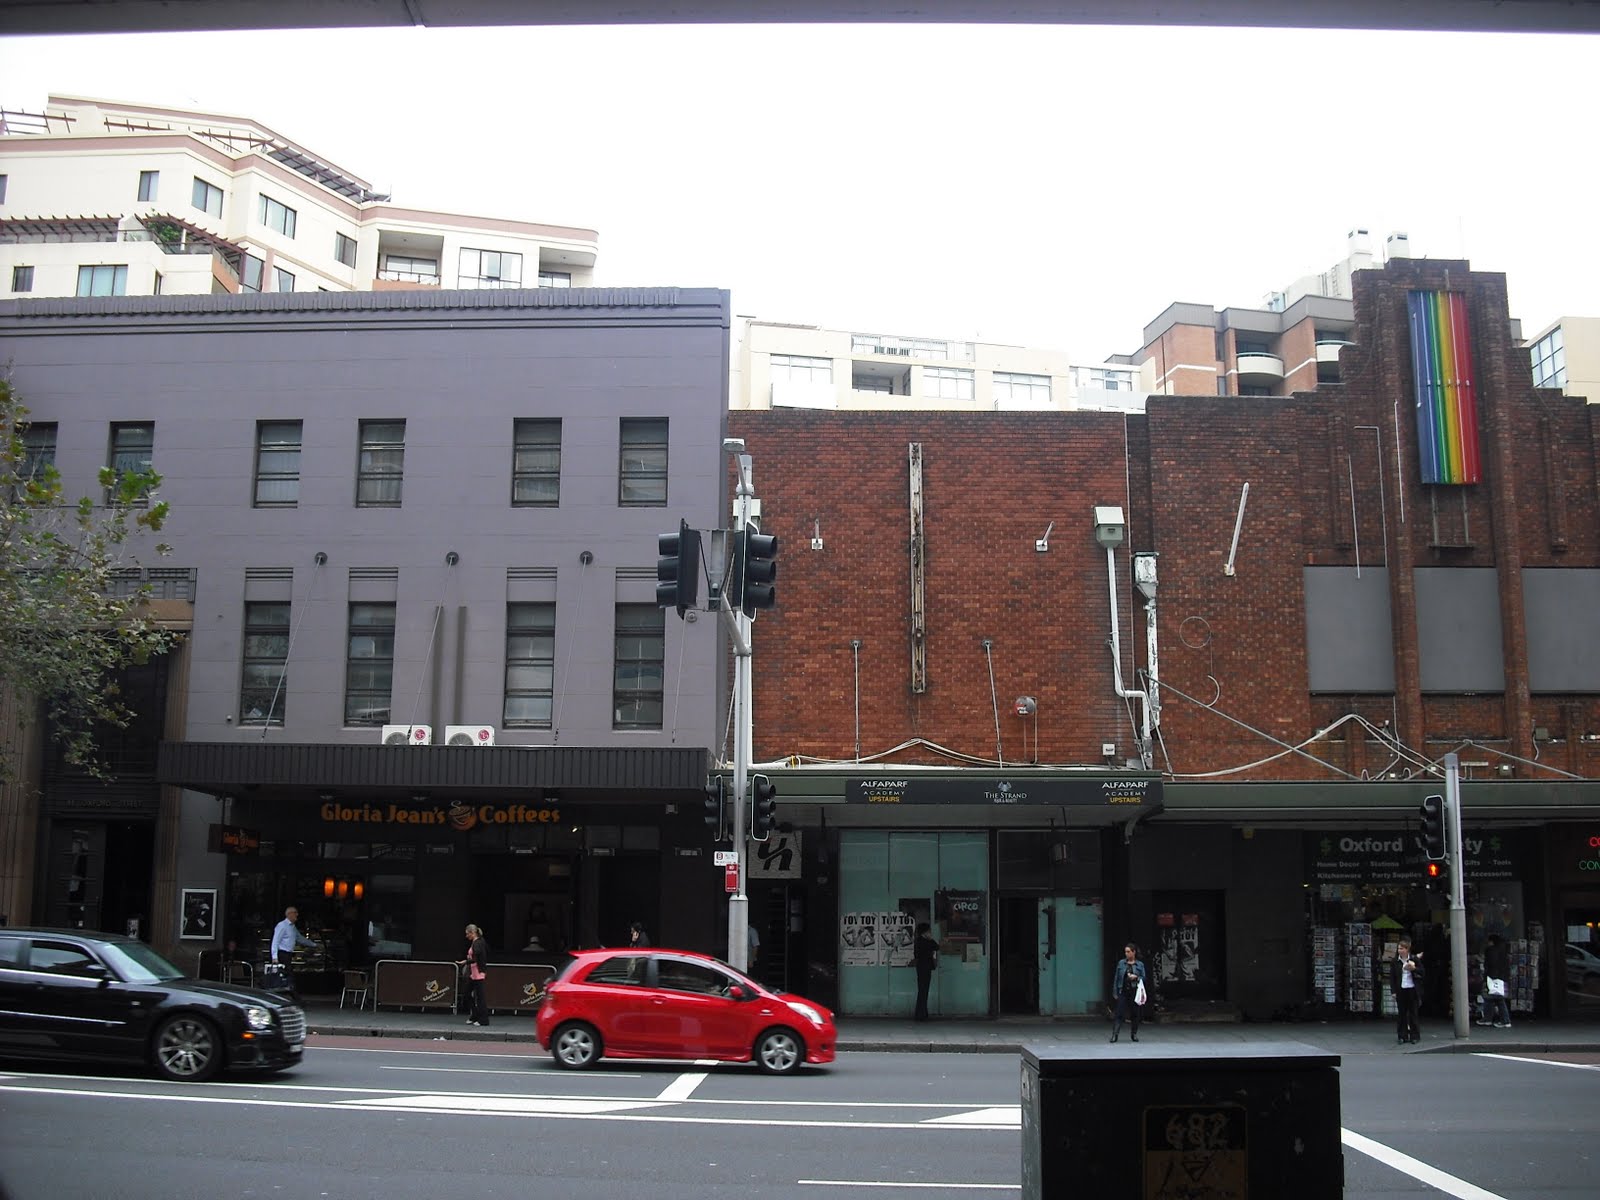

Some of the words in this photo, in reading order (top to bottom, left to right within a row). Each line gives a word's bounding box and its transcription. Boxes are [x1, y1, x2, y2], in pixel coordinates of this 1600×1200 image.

[1101, 781, 1149, 789] ALFAPARF
[984, 791, 999, 799] THE
[1001, 791, 1027, 799] STRAND
[319, 802, 383, 823] Gloria
[385, 803, 447, 825] Jean's
[479, 803, 561, 825] Coffees
[1339, 837, 1403, 852] Oxford
[860, 915, 876, 925] TOY
